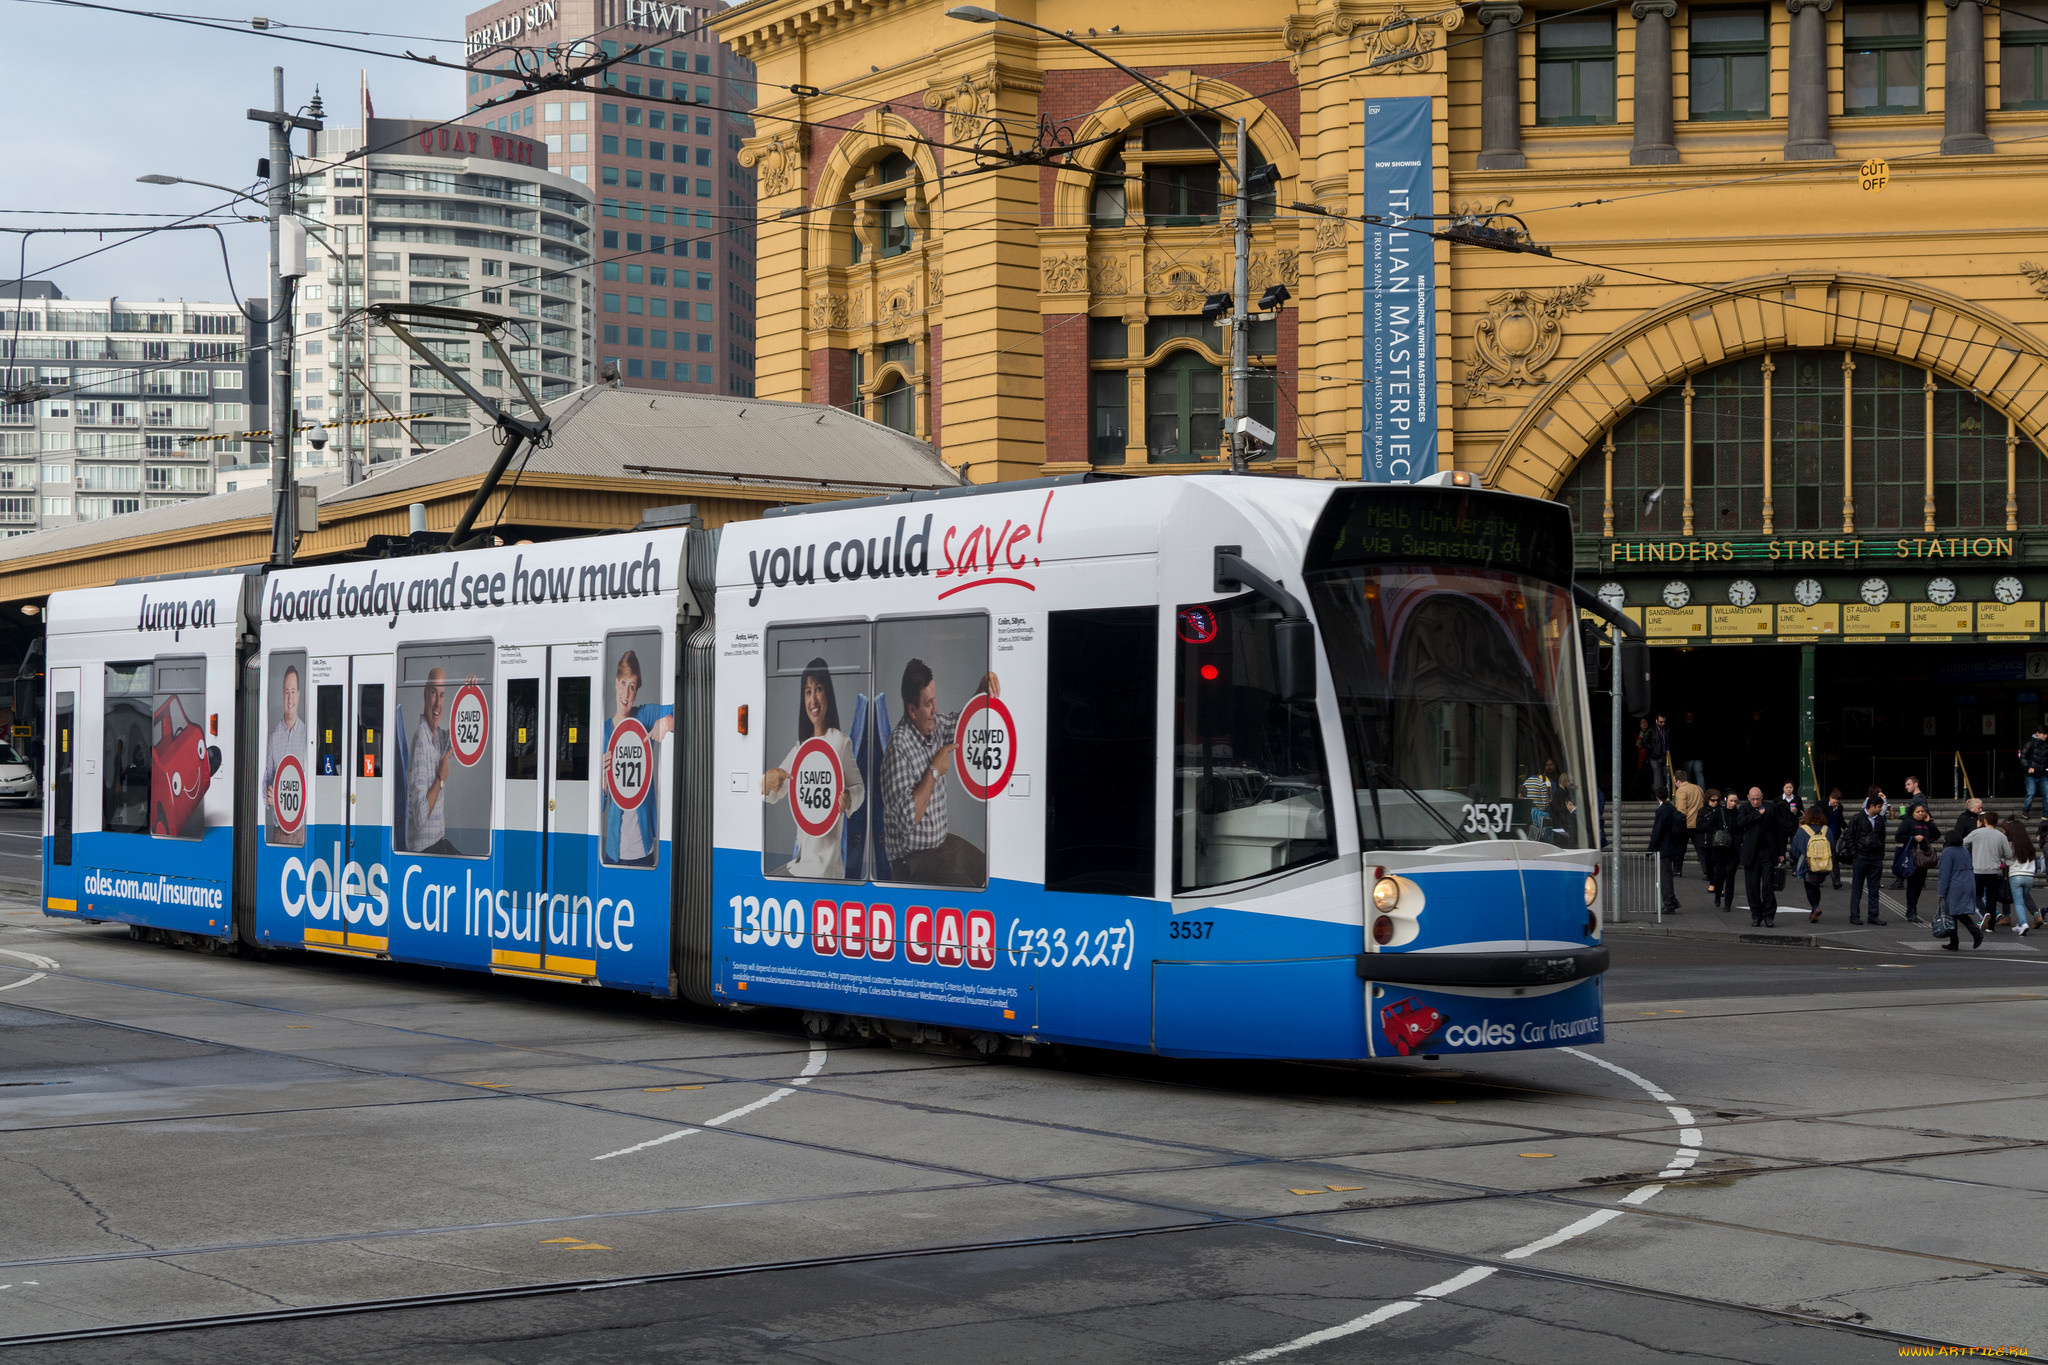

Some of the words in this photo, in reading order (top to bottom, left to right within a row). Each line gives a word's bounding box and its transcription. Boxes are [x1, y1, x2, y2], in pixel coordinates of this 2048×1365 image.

[464, 14, 521, 58] HERALD
[526, 0, 557, 32] SUN
[626, 0, 691, 32] HWT
[420, 127, 476, 154] QUAY
[490, 135, 533, 164] WEST
[1861, 163, 1885, 176] CUT
[1862, 177, 1886, 190] OFF
[1389, 189, 1410, 293] ITALIAN
[1374, 337, 1382, 373] COURT,
[1367, 506, 1410, 529] Melb
[1421, 510, 1516, 537] University
[749, 544, 815, 607] you
[824, 514, 933, 582] could
[936, 490, 1054, 578] save!
[1362, 532, 1391, 553] via
[1402, 534, 1492, 561] Swanston
[1612, 542, 1734, 562] FLINDERS
[1768, 540, 1864, 560] STREET
[1896, 537, 2013, 558] STATION
[270, 574, 335, 623] board
[336, 569, 405, 629] today
[408, 561, 459, 613] and
[461, 572, 506, 609] see
[512, 554, 574, 605] how
[579, 542, 660, 602] much
[138, 594, 187, 642] Jump
[192, 599, 215, 628] on
[1938, 660, 1986, 673] Customer
[1987, 658, 2024, 671] Service
[460, 710, 480, 722] SAVED
[457, 724, 479, 743] $242
[972, 729, 1004, 744] SAVED
[619, 746, 642, 759] SAVED
[967, 746, 1001, 770] $463
[283, 780, 299, 792] SAVED
[615, 761, 642, 787] $121
[804, 770, 832, 784] SAVED
[280, 793, 298, 811] $100
[800, 786, 831, 810] $468
[1462, 803, 1513, 834] 3537
[85, 868, 223, 909] coles.com.au/insurance
[281, 840, 388, 926] coles
[402, 865, 456, 933] Car
[466, 869, 635, 951] Insurance
[729, 895, 804, 949] 1300
[815, 904, 893, 955] RED
[909, 912, 993, 964] CAR
[1169, 921, 1214, 939] 3537
[733, 961, 748, 972] Savings
[756, 963, 771, 973] depend
[893, 977, 913, 987] Standard
[869, 986, 880, 995] Coles
[967, 996, 989, 1006] Insurance
[1445, 1019, 1516, 1047] coles
[1521, 1022, 1546, 1043] Car
[1550, 1015, 1599, 1041] Insurance
